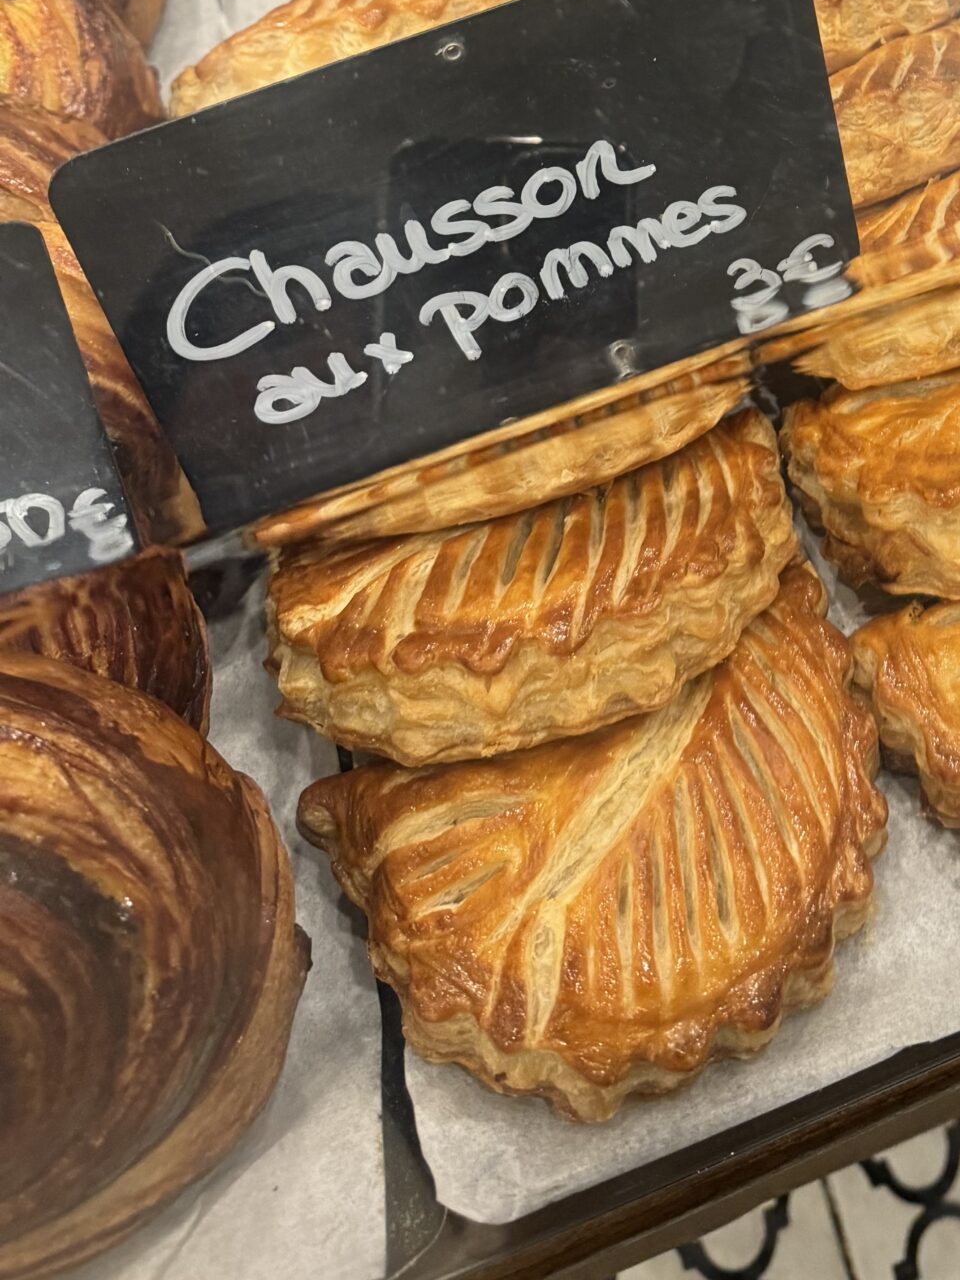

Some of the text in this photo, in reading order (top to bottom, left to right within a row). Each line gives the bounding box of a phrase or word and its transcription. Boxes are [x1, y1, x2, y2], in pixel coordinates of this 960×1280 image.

[166, 139, 656, 361] Chausson
[254, 185, 747, 424] aux pommes
[727, 233, 851, 326] 3€
